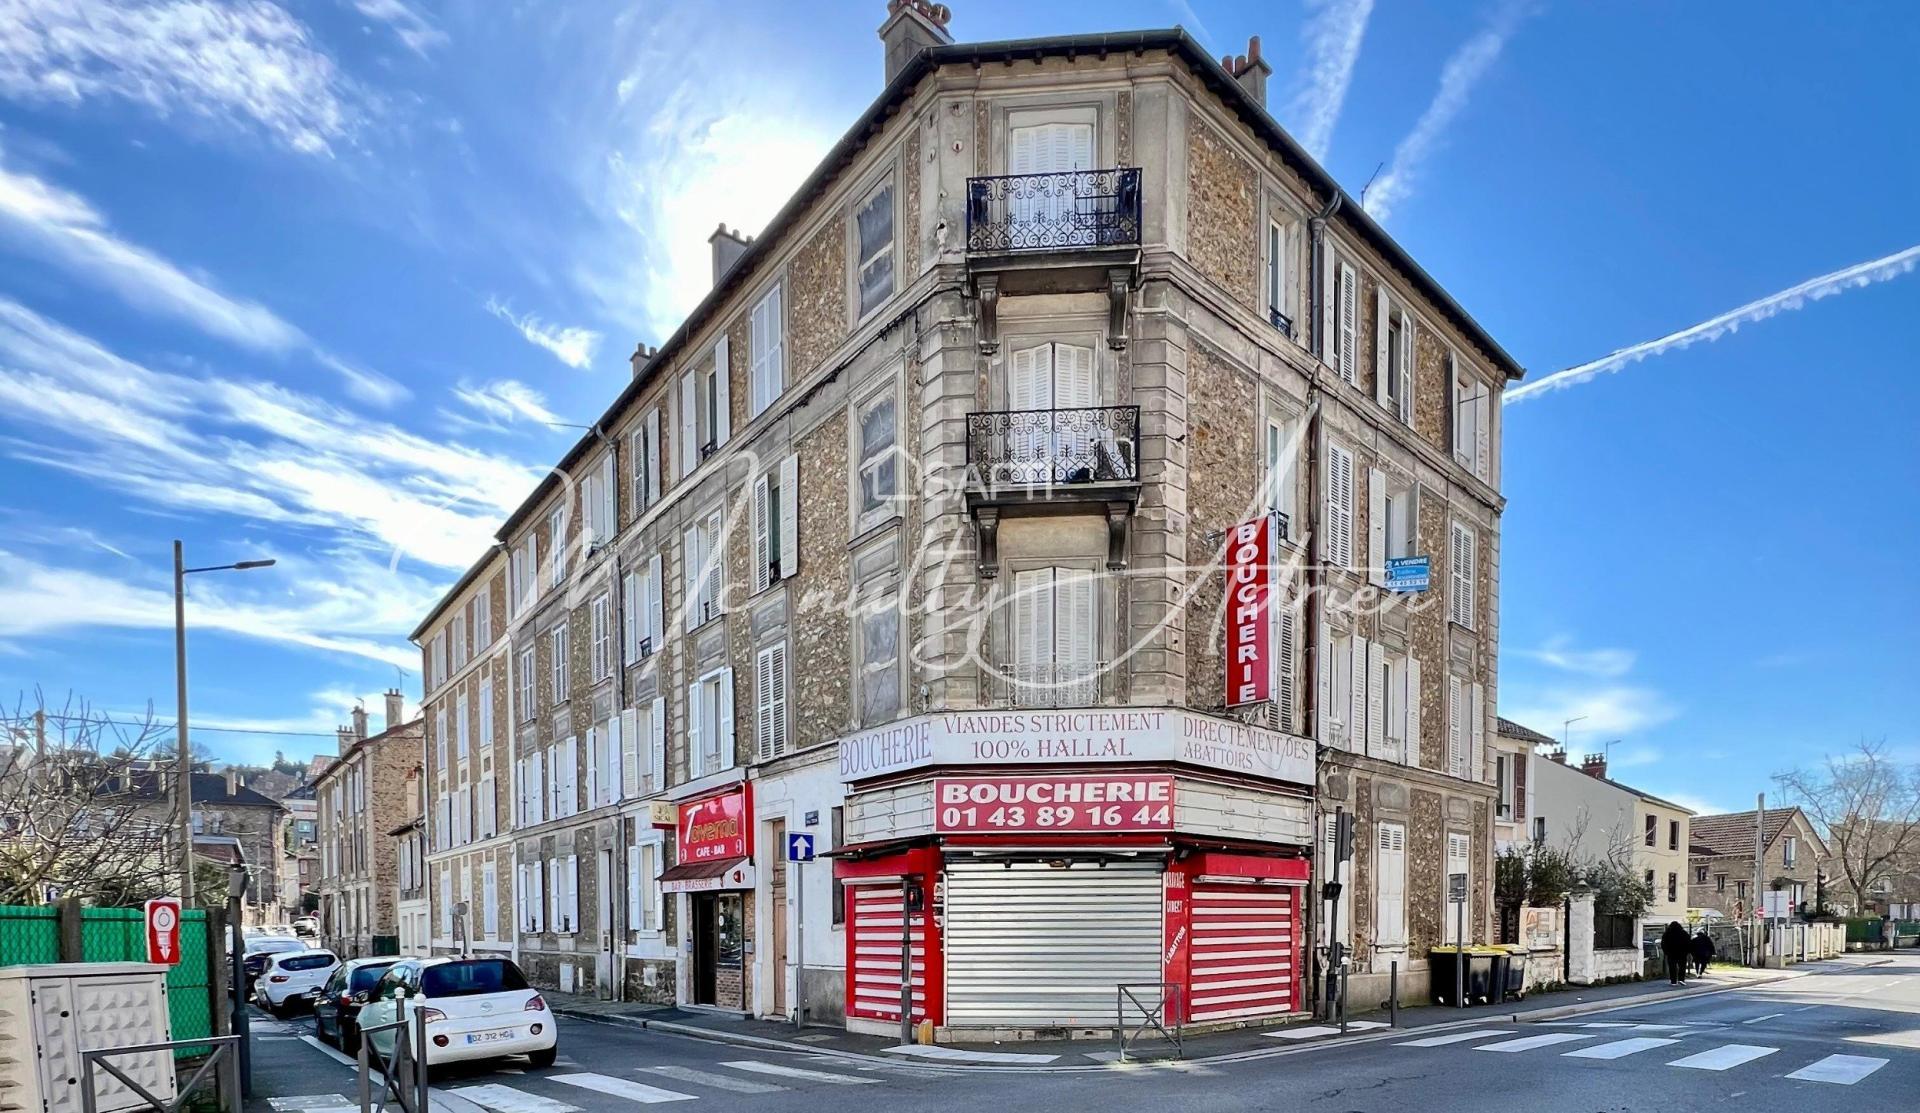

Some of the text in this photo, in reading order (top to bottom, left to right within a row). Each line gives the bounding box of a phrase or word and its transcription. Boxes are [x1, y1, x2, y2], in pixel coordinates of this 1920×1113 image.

[1235, 523, 1259, 703] BOUCHERIE
[944, 712, 1165, 734] VIANDES STRICTEMENT
[840, 721, 932, 776] BOUCHERIE
[974, 738, 1133, 759] 100% HALLAL
[1183, 716, 1310, 761] DIRECTEMENT DES
[1183, 741, 1253, 770] ABATTOIRS
[943, 781, 1170, 804] BOUCHERIE
[943, 804, 1171, 828] 01 43 89 16 44
